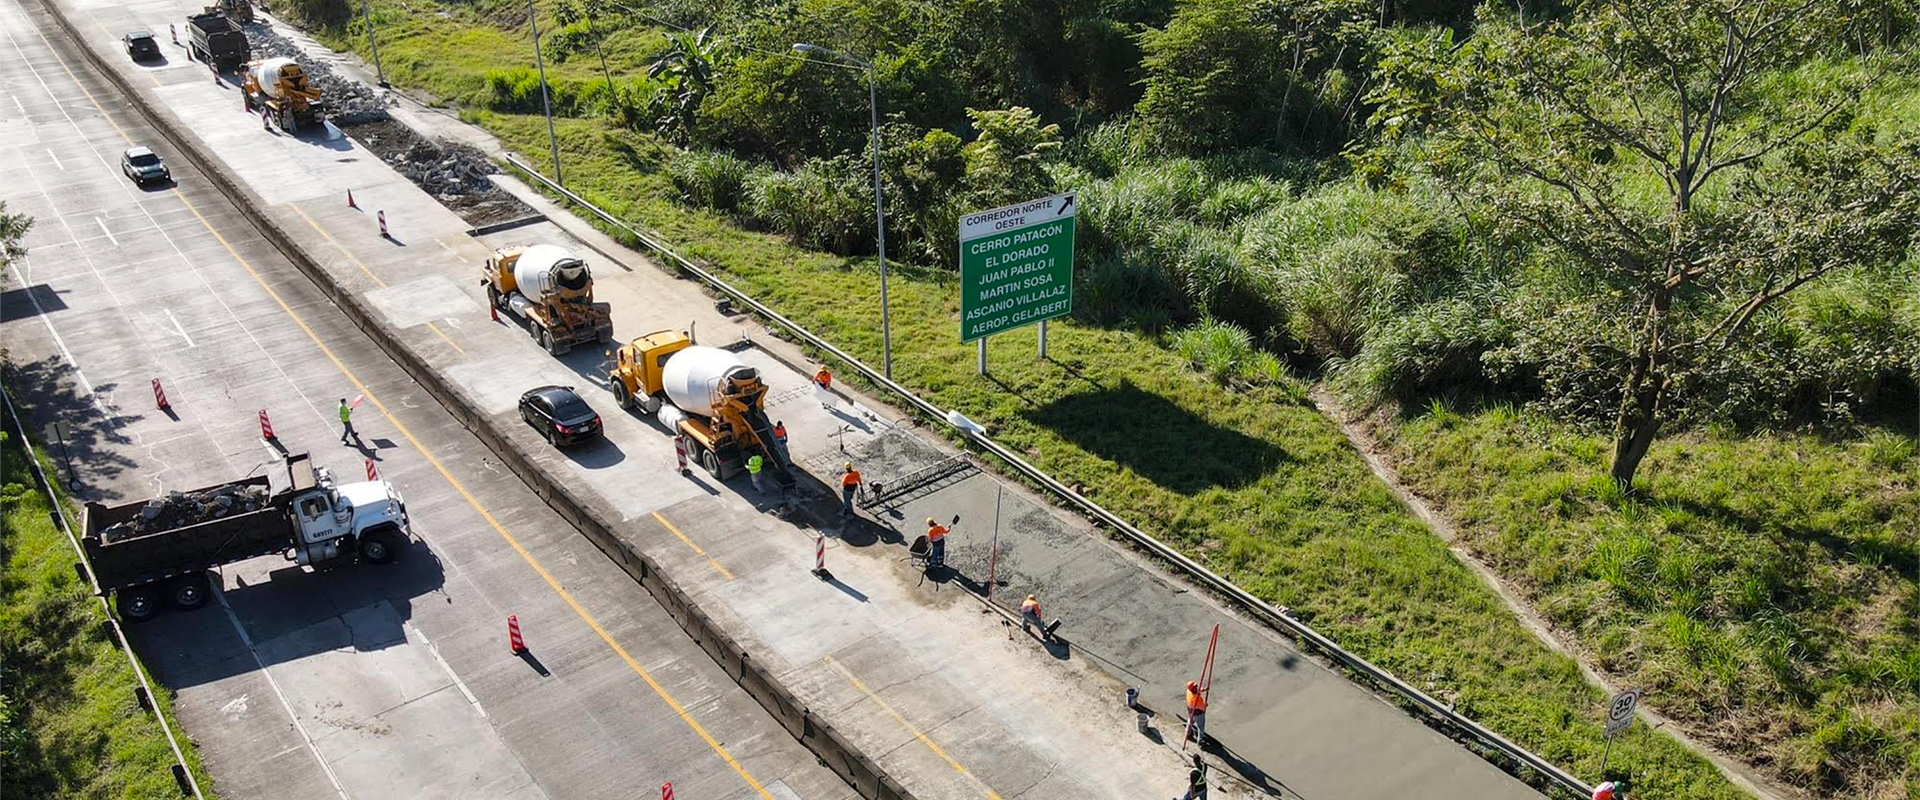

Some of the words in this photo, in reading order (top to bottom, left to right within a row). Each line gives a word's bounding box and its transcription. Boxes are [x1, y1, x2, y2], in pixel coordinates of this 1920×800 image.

[966, 207, 1020, 226] CORREDOR
[1022, 200, 1053, 214] NORTE
[995, 216, 1026, 230] OESTE
[971, 237, 1011, 255] CERRO
[1014, 224, 1062, 244] PATACÓN
[986, 256, 999, 268] EL
[1002, 244, 1050, 264] DORADO
[979, 270, 1008, 286] JUAN
[1010, 260, 1046, 277] PABLO
[1048, 258, 1055, 268] II
[980, 281, 1021, 302] MARTIN
[1024, 274, 1052, 289] SOSA
[966, 299, 1014, 321] ASCANIO
[1016, 284, 1066, 306] VILLALAZ
[971, 316, 1010, 335] AEROP.
[1012, 300, 1068, 323] GELABERT
[1616, 696, 1632, 710] 30
